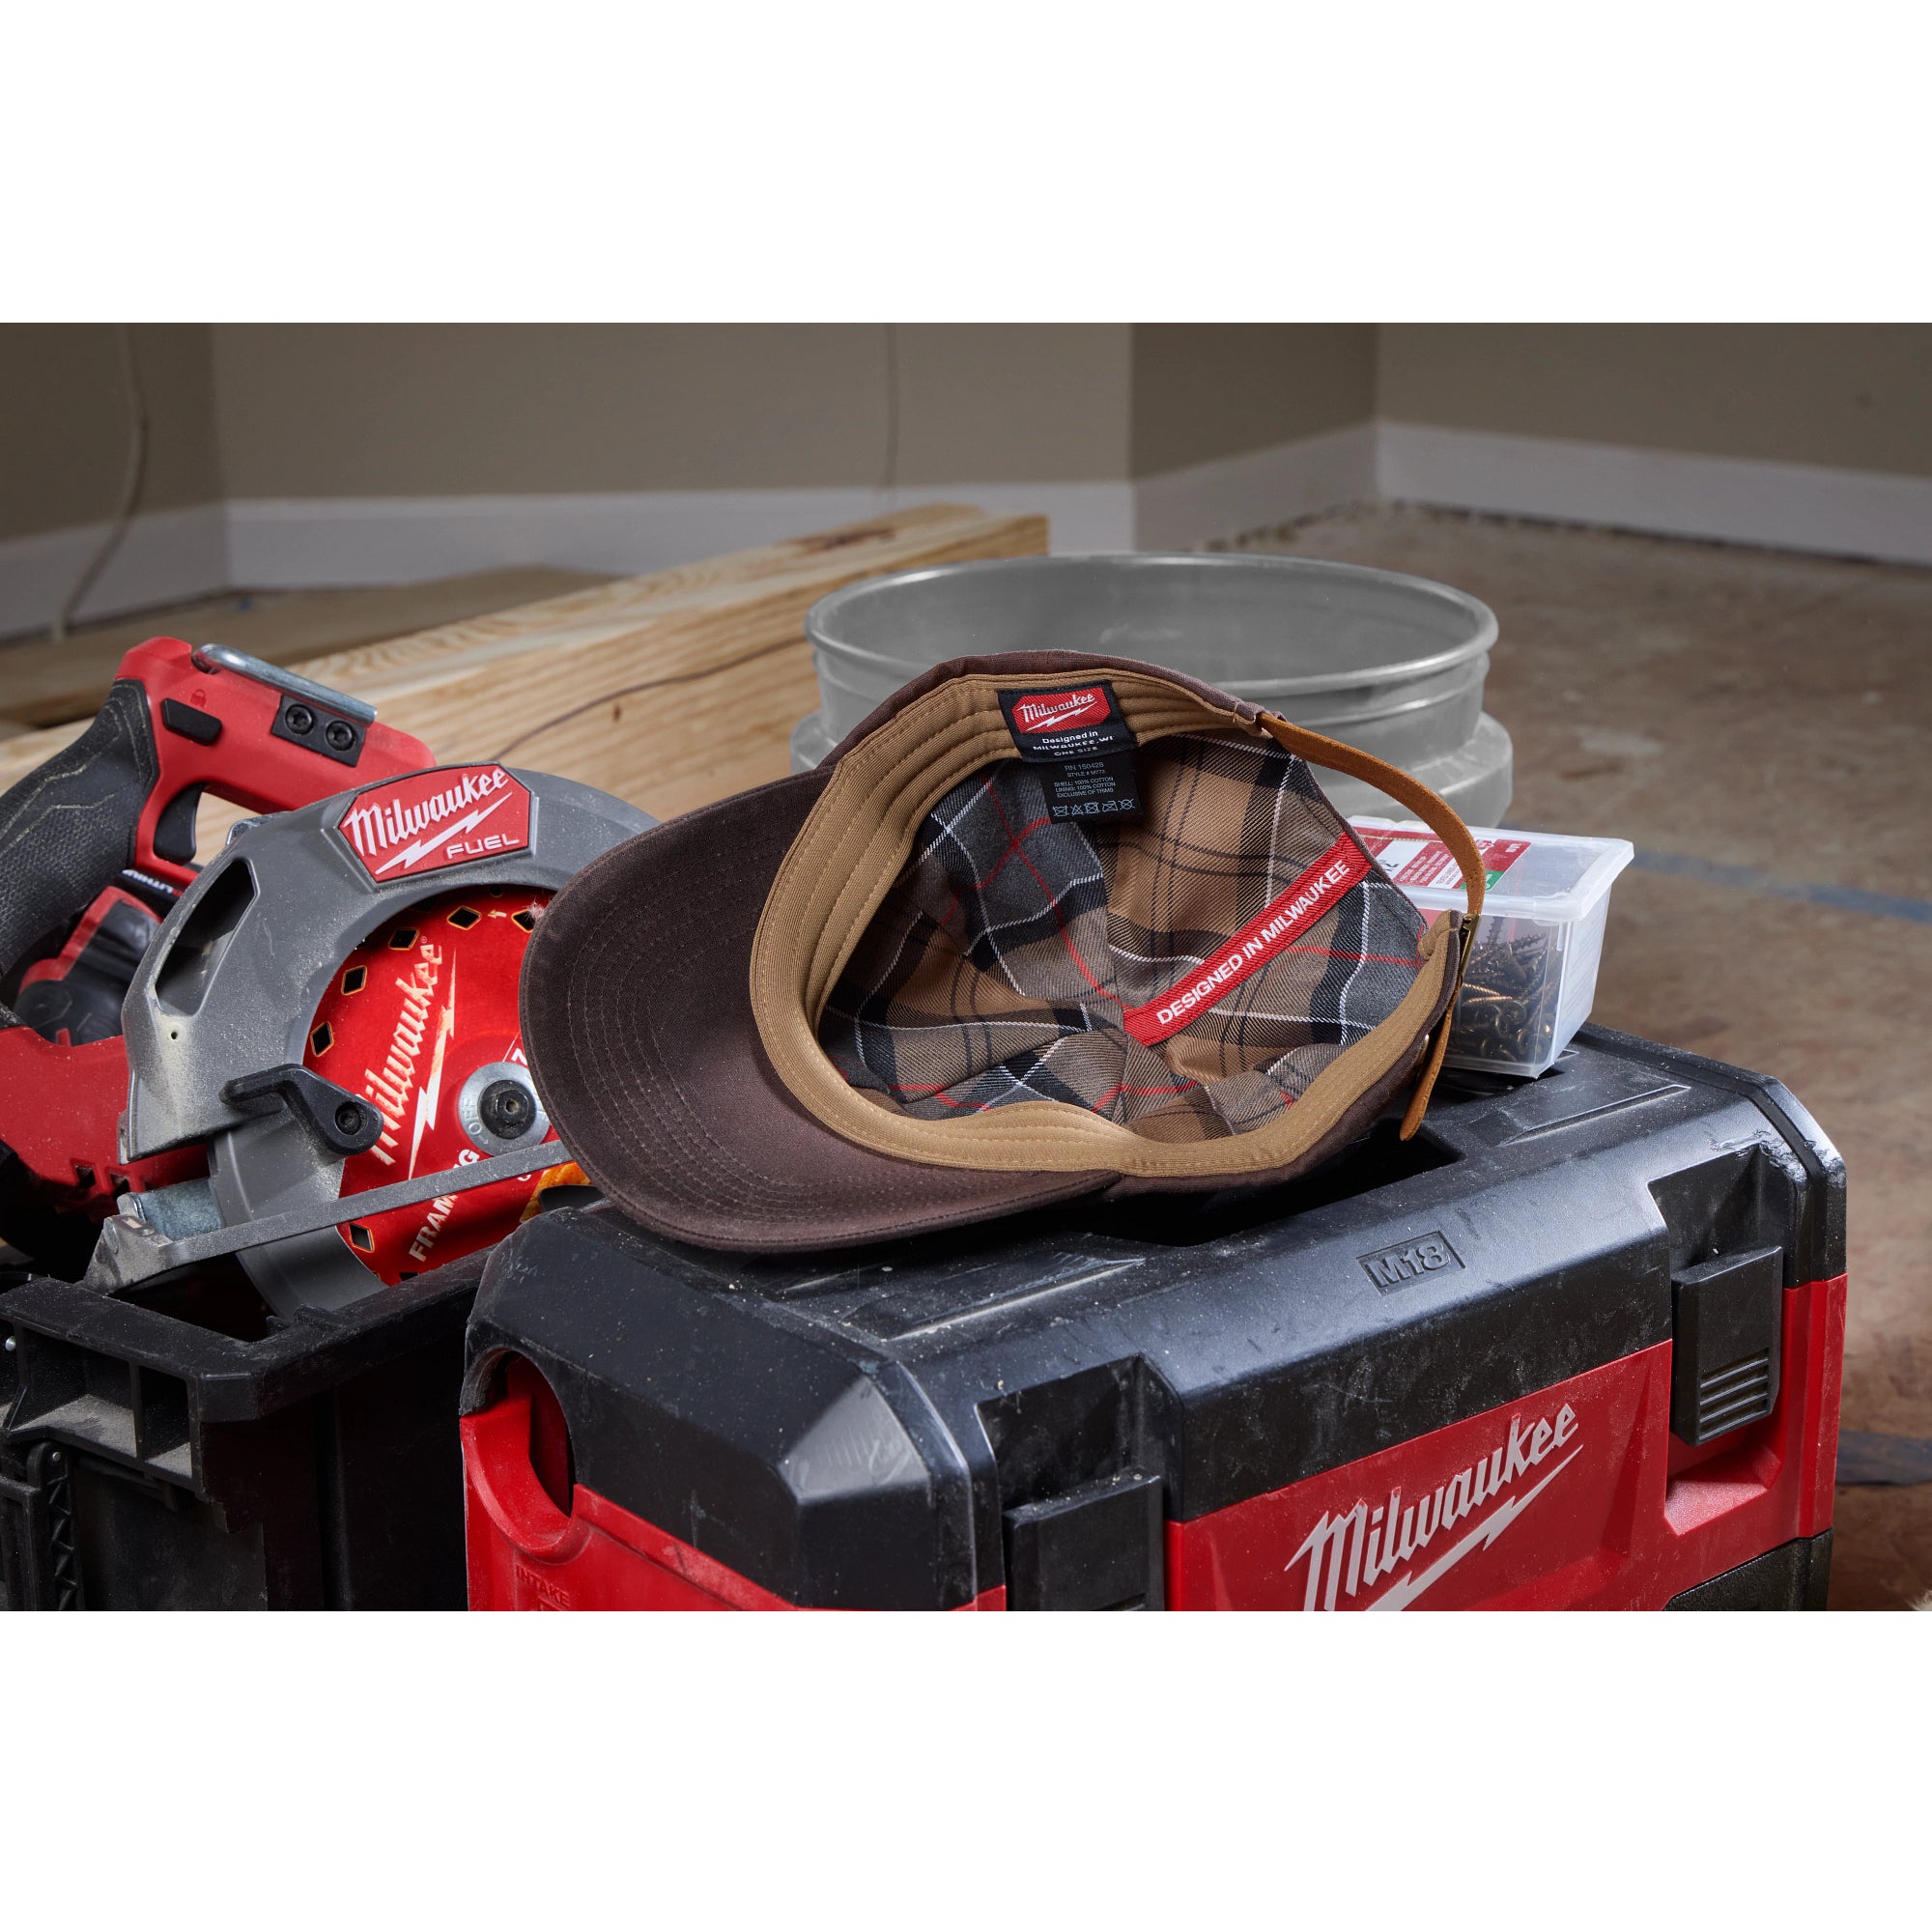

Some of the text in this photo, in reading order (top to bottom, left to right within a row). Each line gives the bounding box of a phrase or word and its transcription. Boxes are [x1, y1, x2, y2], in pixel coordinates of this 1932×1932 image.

[1016, 693, 1095, 724] Milwaukee
[1041, 731, 1088, 744] Designed
[343, 767, 509, 858] Milwaukee
[445, 833, 520, 860] FUEL
[1155, 952, 1244, 1026] DESIGNED
[1242, 935, 1264, 959] IN
[1259, 859, 1351, 944] MILWAUKEE
[409, 1149, 481, 1262] FRAMG
[1365, 1240, 1451, 1289] M18
[1284, 1402, 1579, 1610] Milwaukee
[516, 1564, 571, 1609] INTAKE
